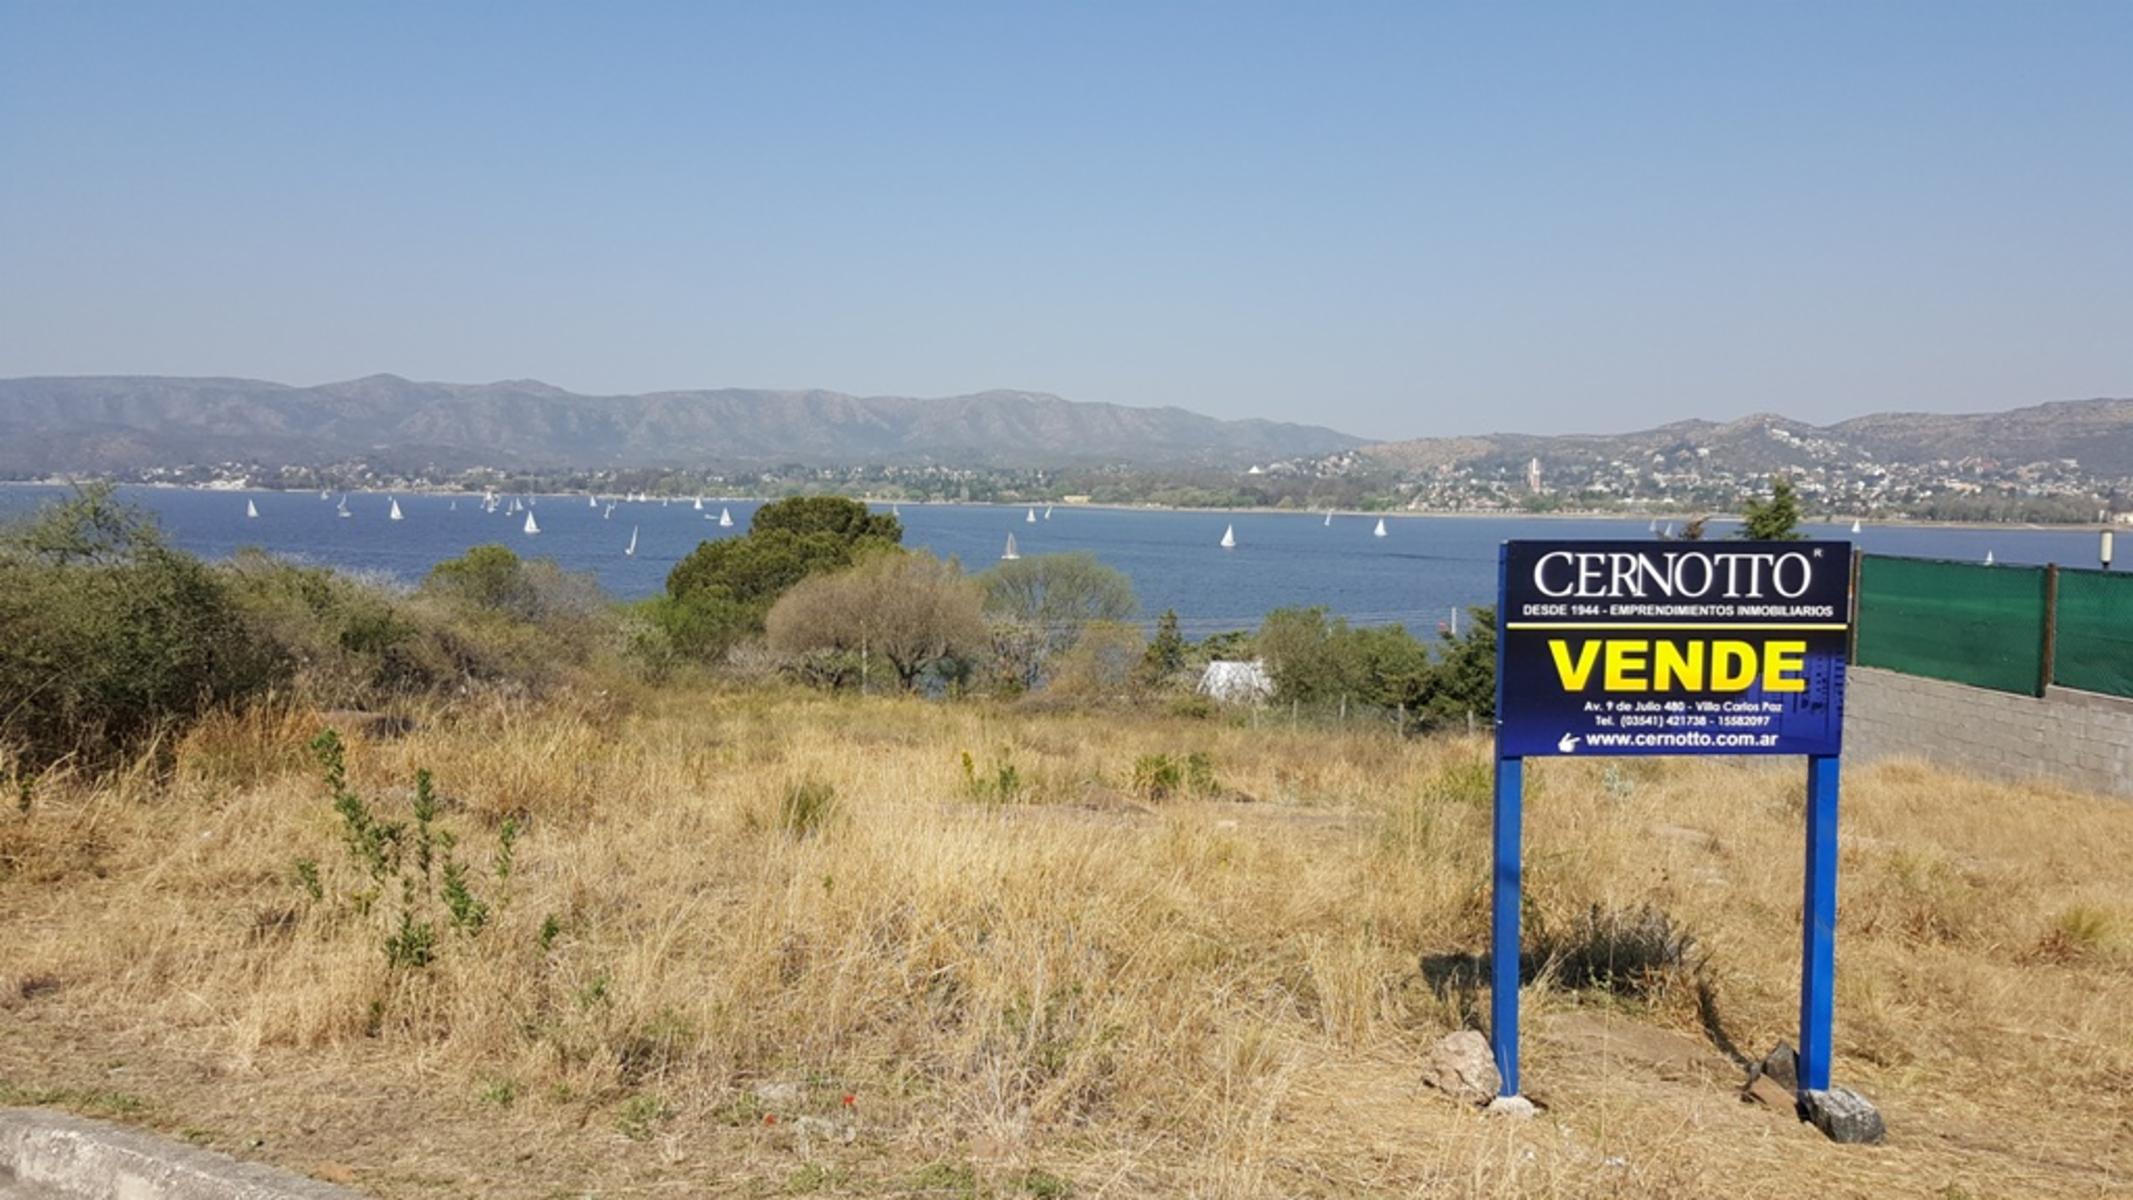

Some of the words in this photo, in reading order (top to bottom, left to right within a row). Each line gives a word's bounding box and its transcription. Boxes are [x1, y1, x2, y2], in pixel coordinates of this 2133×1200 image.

[1533, 551, 1812, 598] CERNOTTO
[1523, 604, 1567, 616] DESDE
[1571, 605, 1599, 616] 1944
[1610, 604, 1734, 617] EMPRENDIMIENTOS
[1737, 605, 1834, 617] INMOBILIARIOS
[1548, 640, 1807, 692] VENDE
[1584, 701, 1603, 712] Av.
[1606, 701, 1613, 711] 9
[1616, 701, 1632, 712] de
[1635, 701, 1661, 712] Julio
[1664, 701, 1685, 712] 480
[1696, 701, 1720, 712] Villa
[1723, 701, 1759, 712] Carlos
[1762, 702, 1782, 712] Paz
[1595, 716, 1615, 726] Tel.
[1620, 715, 1664, 728] (03541)
[1666, 716, 1707, 726] 421738
[1718, 716, 1770, 726] 15582097
[1586, 731, 1779, 746] www.cernotto.com.ar
